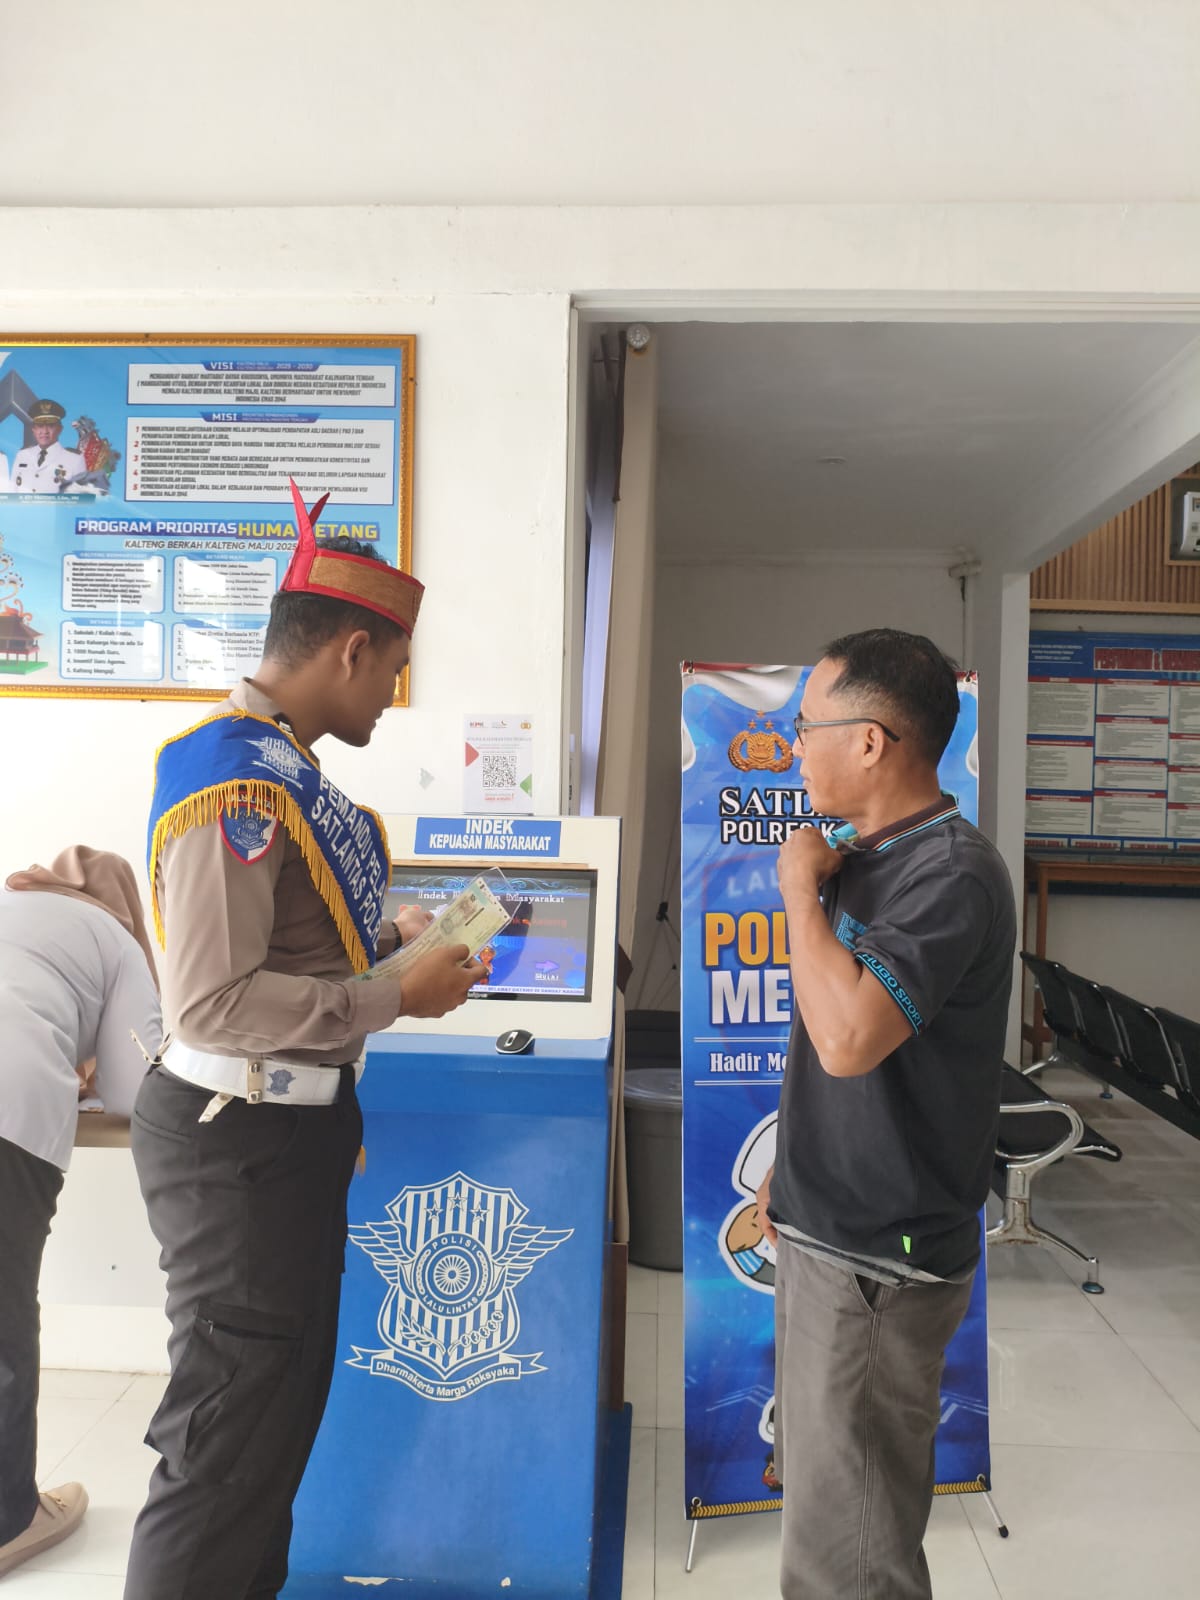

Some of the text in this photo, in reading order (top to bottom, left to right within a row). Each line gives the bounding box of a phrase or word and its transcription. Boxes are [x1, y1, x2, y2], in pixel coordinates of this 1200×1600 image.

[78, 520, 378, 538] PROGRAM PRIORITAS HUMA ETANG
[124, 540, 165, 549] KALTENG
[167, 540, 203, 550] BERKAH
[204, 541, 246, 550] KALTENG
[248, 542, 274, 550] MAJU
[721, 788, 820, 817] SATL
[319, 774, 374, 861] PEMANDU
[466, 819, 514, 834] INDEK
[311, 795, 367, 901] SATLANTAS
[430, 834, 551, 851] KEPUASAN MASYARAKAT
[418, 890, 447, 900] Indek
[506, 892, 565, 904] Masyarakat
[705, 911, 791, 966] POL
[862, 953, 898, 988] HUGO
[711, 969, 793, 1024] ME
[710, 1053, 762, 1072] Hadir
[432, 1236, 477, 1251] POLISI
[422, 1296, 478, 1314] LALU LINTAS
[376, 1361, 515, 1398] Dharmakerta Marga Raksyaka
